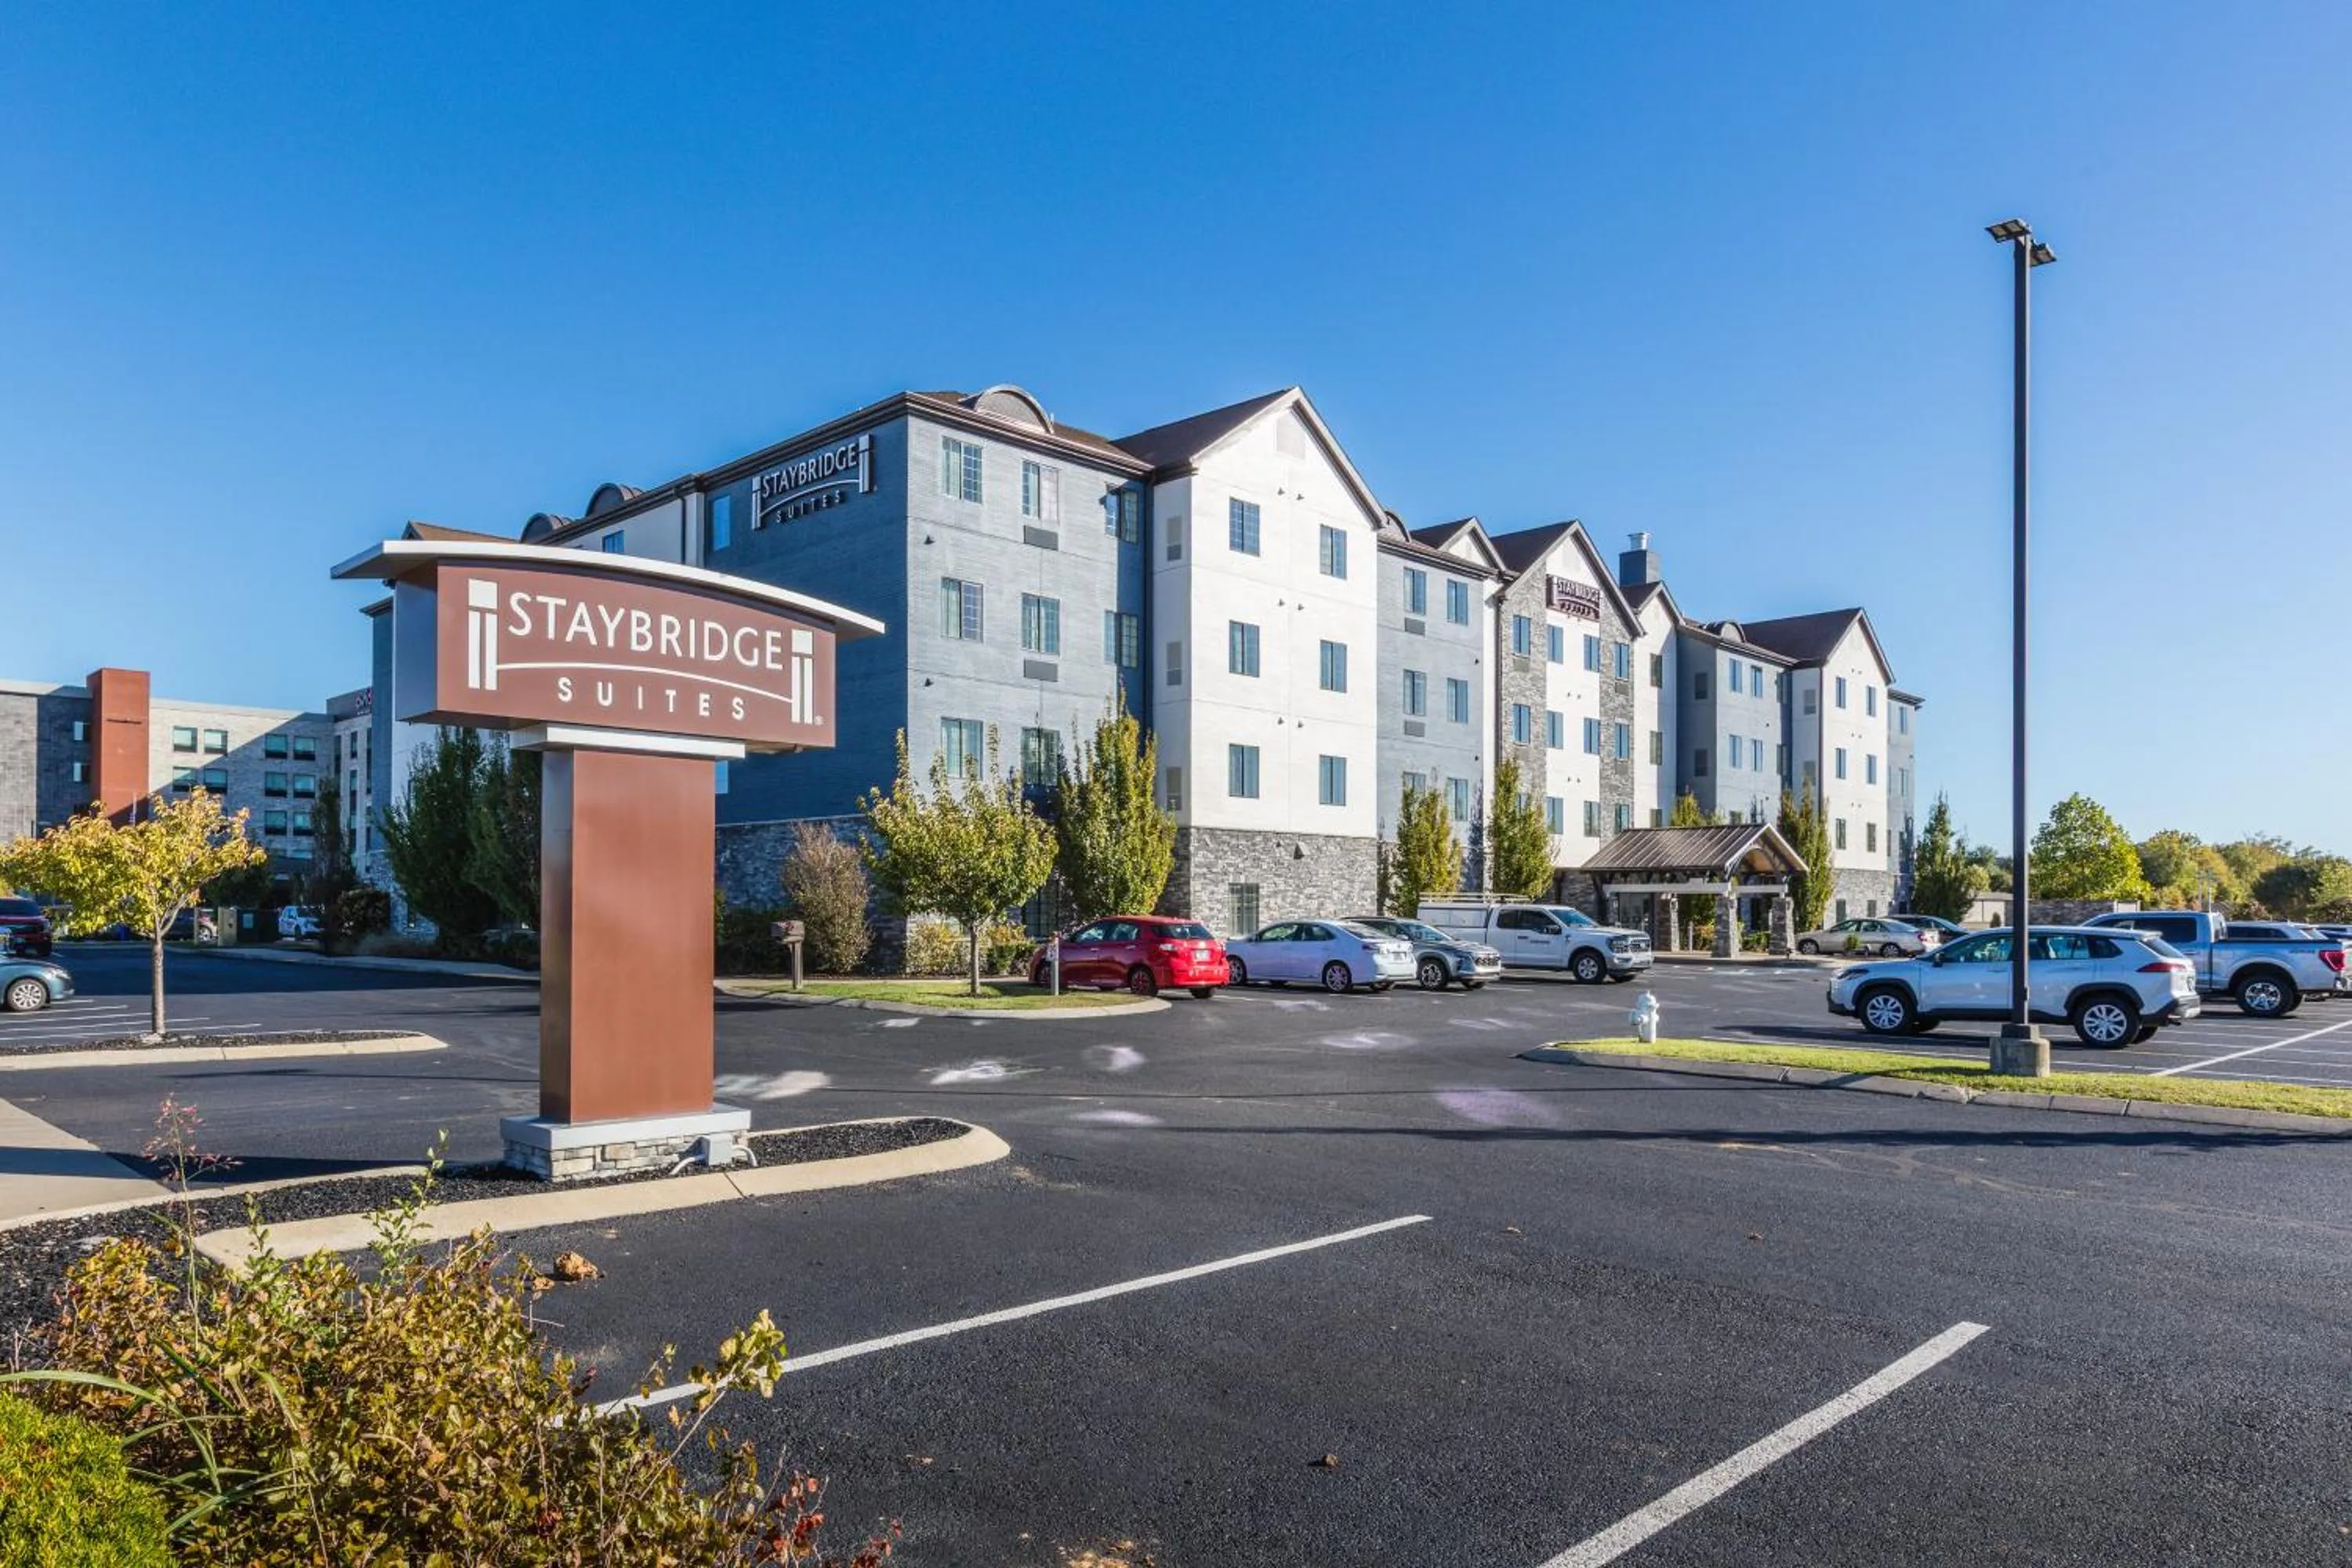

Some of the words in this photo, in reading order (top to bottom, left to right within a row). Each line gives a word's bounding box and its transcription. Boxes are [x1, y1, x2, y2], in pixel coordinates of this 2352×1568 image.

[762, 443, 857, 498] STAYBRIDGE
[776, 488, 840, 523] SUITES
[508, 592, 783, 670] STAYBRIDGE
[557, 677, 745, 720] SUITES
